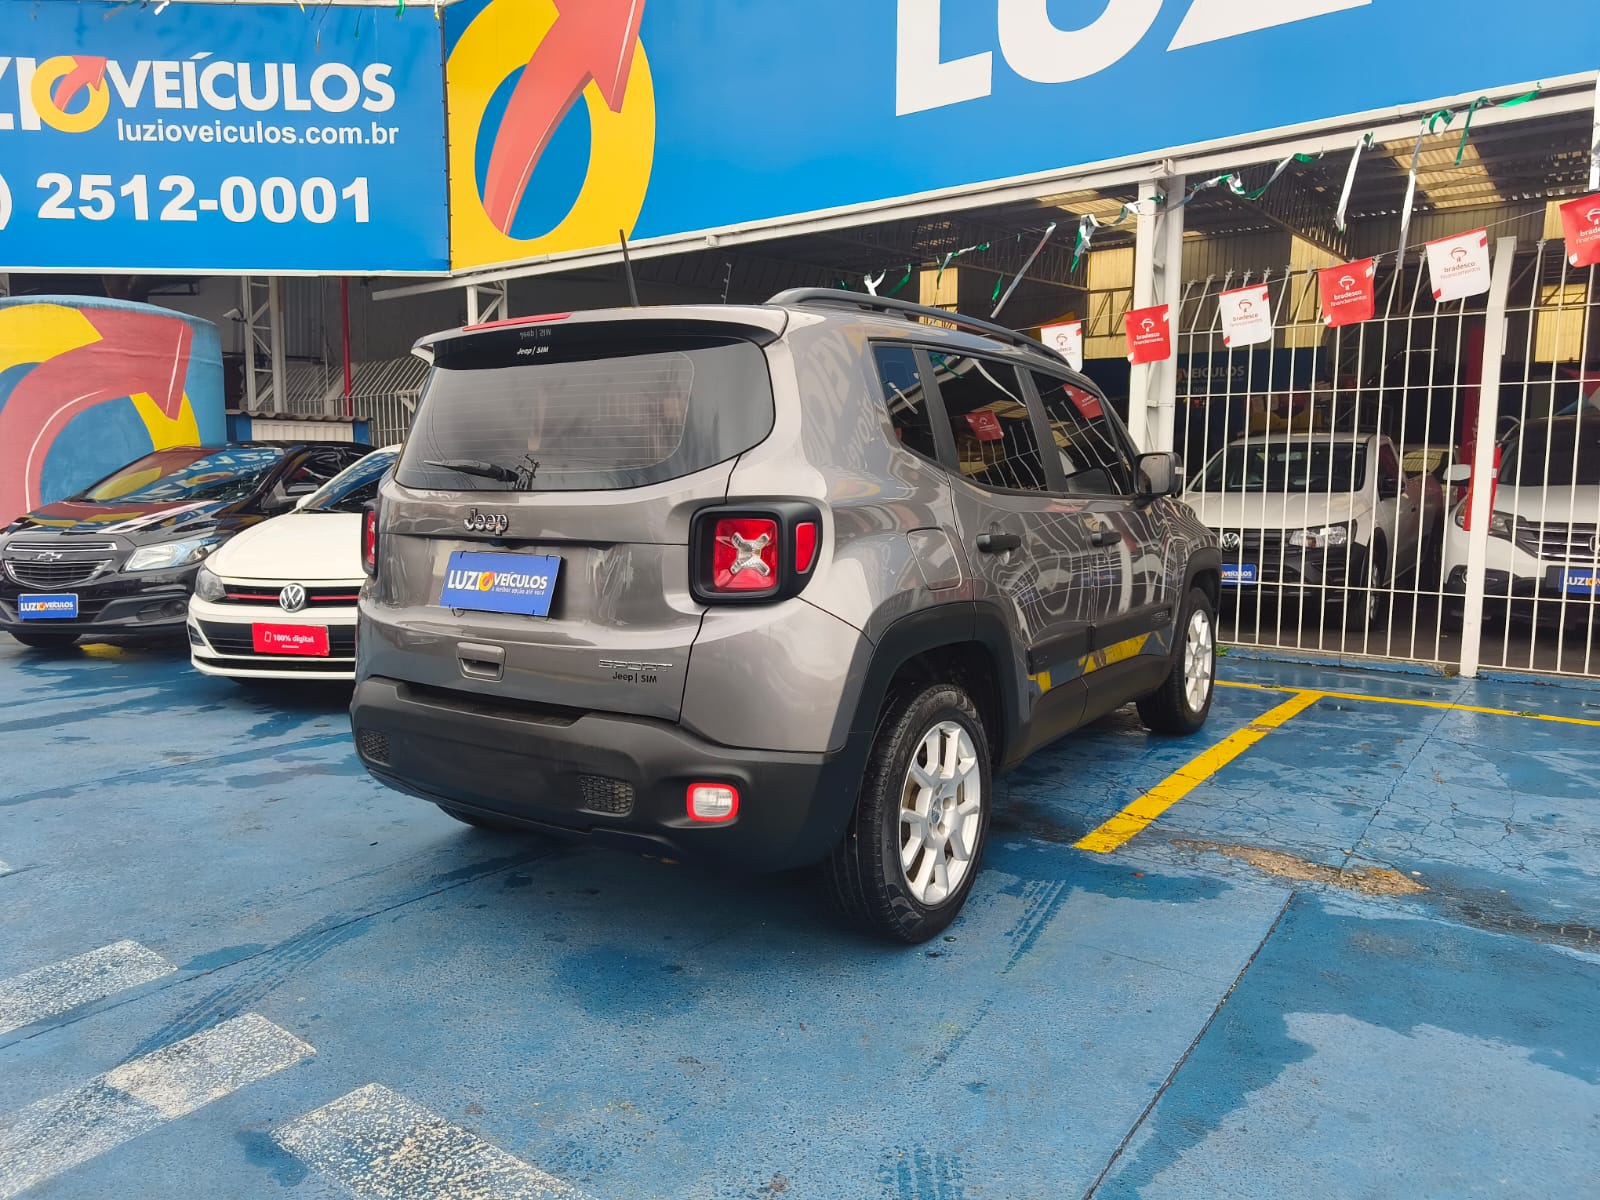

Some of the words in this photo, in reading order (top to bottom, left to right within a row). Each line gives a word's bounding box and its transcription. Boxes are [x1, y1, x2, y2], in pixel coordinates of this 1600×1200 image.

[105, 52, 396, 112] VEÍCULOS
[117, 119, 400, 146] luzioveiculos.com.br
[36, 172, 370, 224] 2512-0001
[1334, 290, 1362, 300] bradesco
[463, 508, 509, 536] Jeep
[273, 634, 292, 642] 100%
[292, 634, 315, 644] digital
[612, 671, 634, 683] Jeep
[641, 674, 657, 684] SIM
